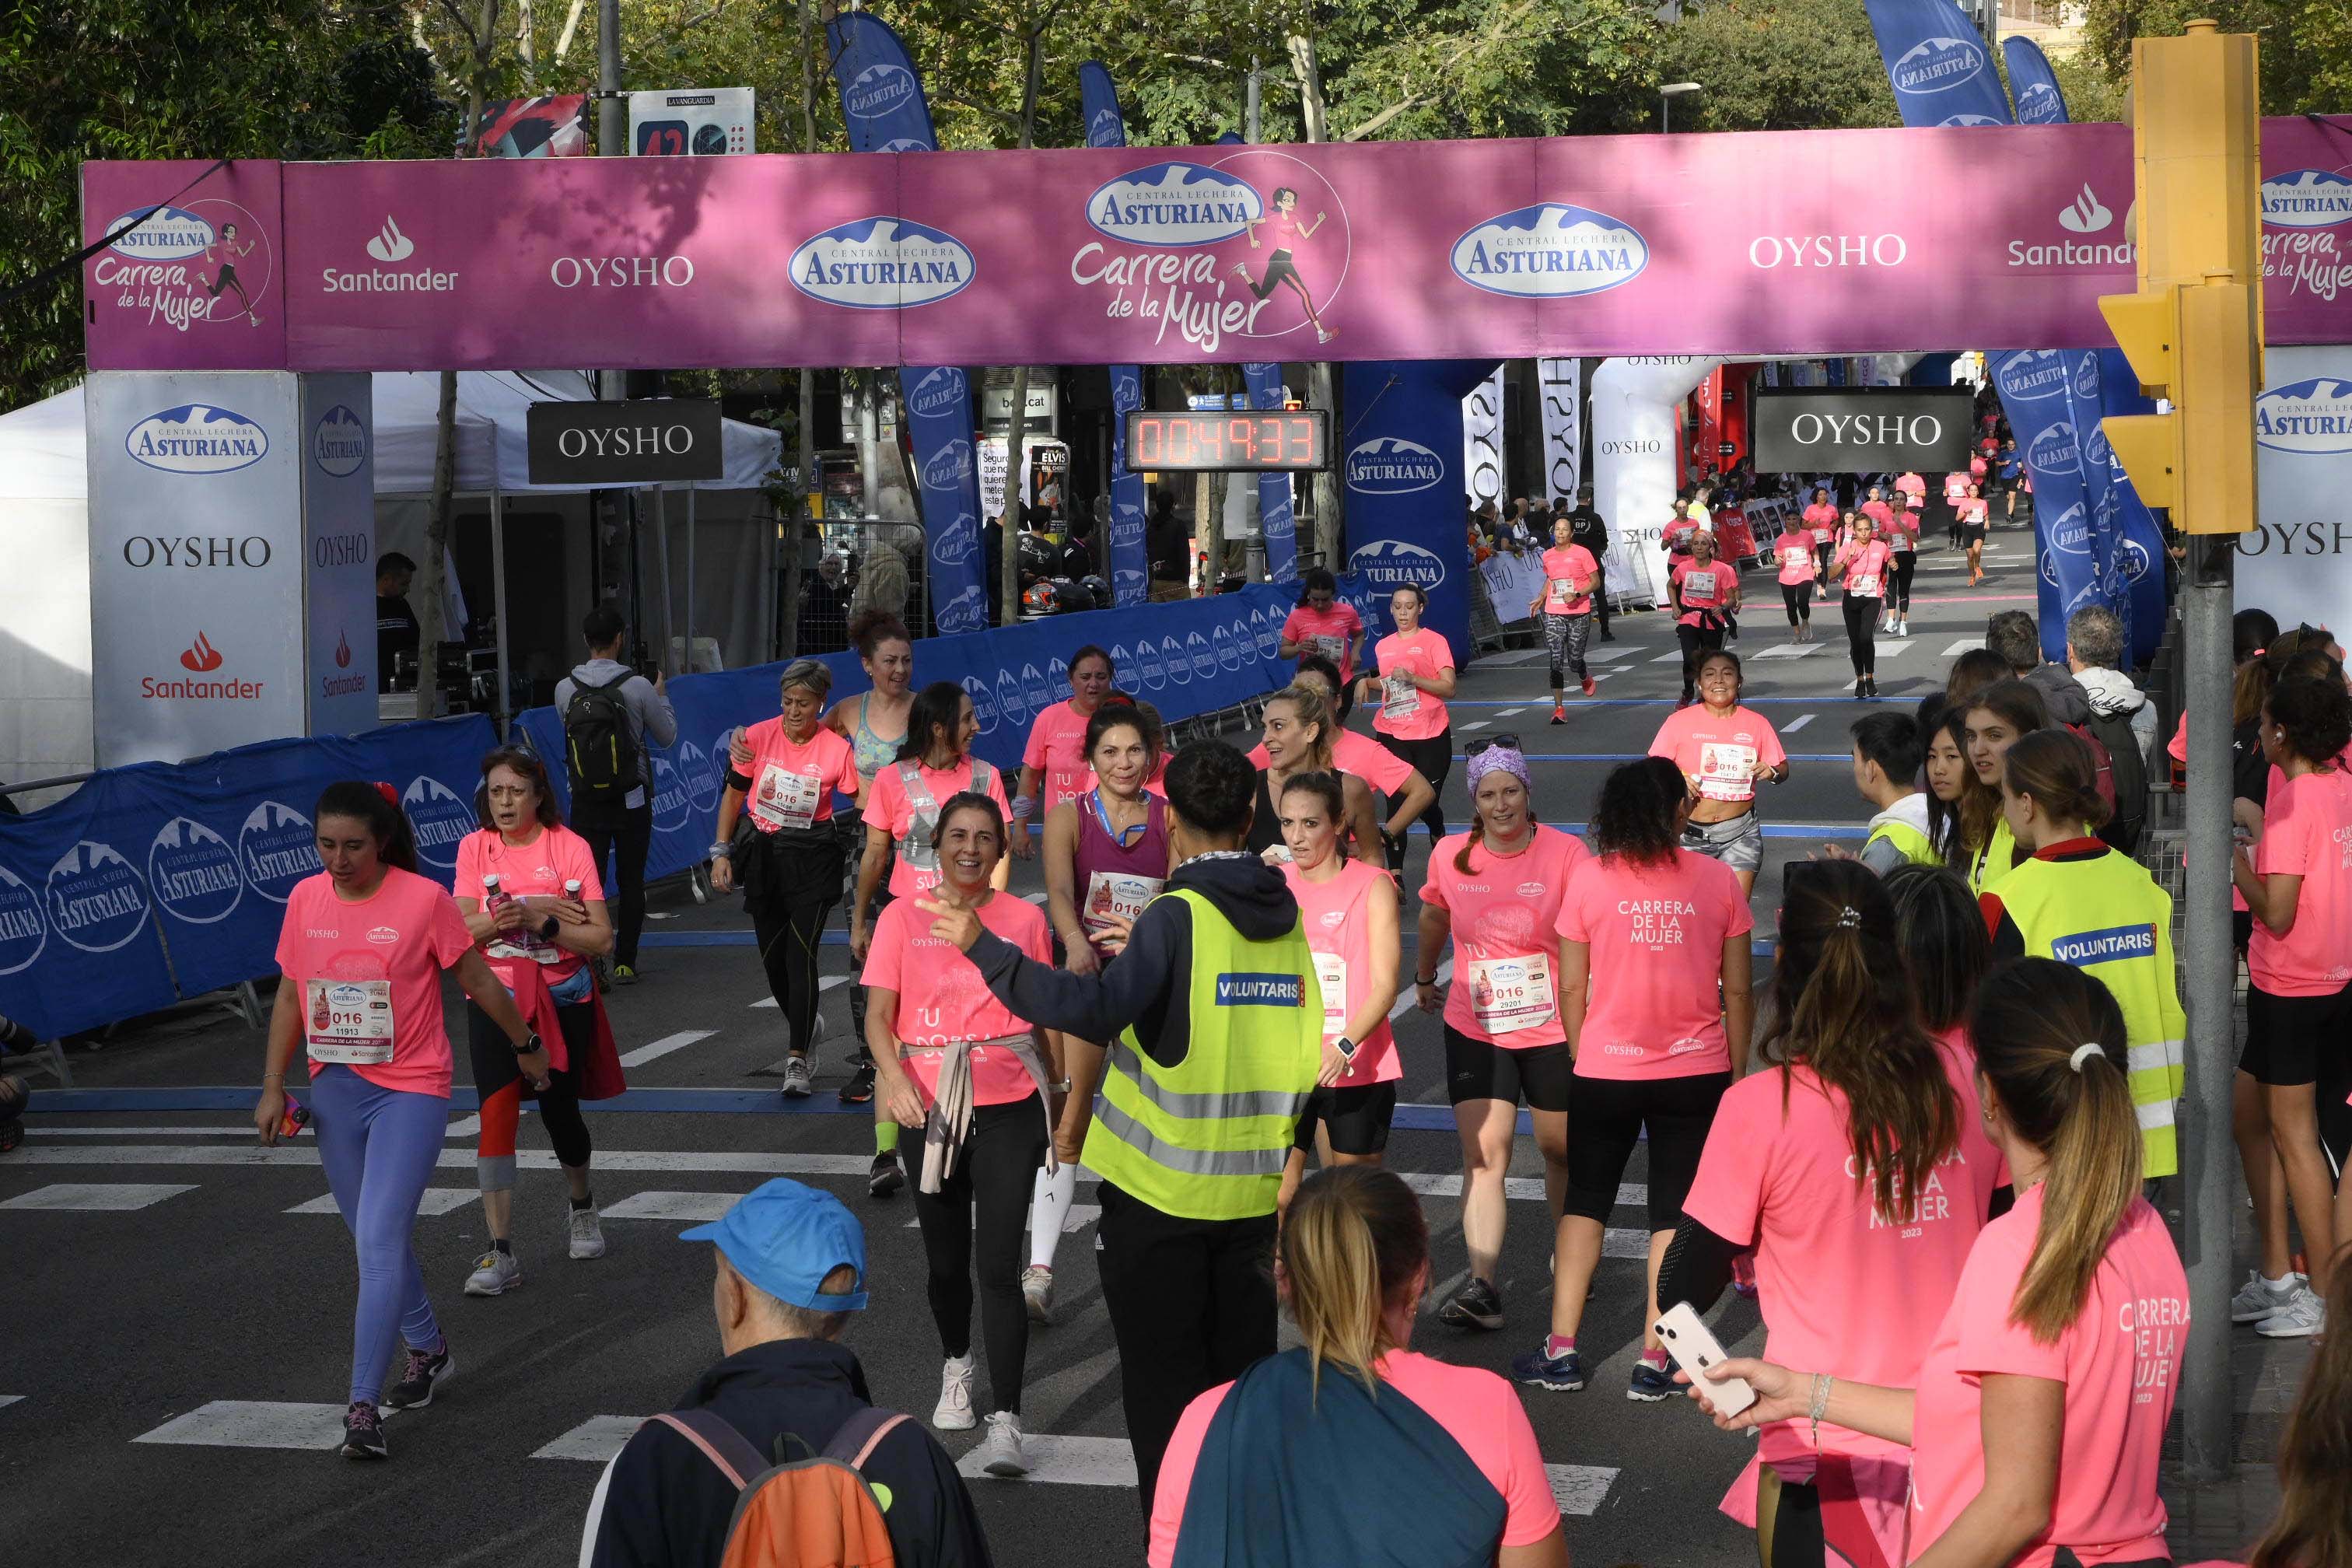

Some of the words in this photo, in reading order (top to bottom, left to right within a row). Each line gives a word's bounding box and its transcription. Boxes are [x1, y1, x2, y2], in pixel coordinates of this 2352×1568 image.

[677, 96, 715, 106] VANGUARDIA
[1126, 191, 1182, 200] CENTRAL
[1188, 190, 1244, 199] LECHERA
[1100, 194, 1248, 225] ASTURIANA
[114, 226, 207, 247] ASTURIANA
[1496, 236, 1556, 247] CENTRAL
[1563, 234, 1626, 245] LECHERA
[2261, 232, 2336, 255] arrera
[831, 249, 890, 258] CENTRAL
[896, 247, 955, 257] LECHERA
[1465, 240, 1633, 275] ASTURIANA
[1748, 234, 1907, 268] OYSHO
[95, 257, 187, 286] Carrera
[551, 256, 694, 287] OYSHO
[803, 251, 961, 285] ASTURIANA
[1071, 242, 1216, 285] Carrera
[2280, 255, 2294, 276] la
[323, 268, 459, 292] Santander
[118, 287, 135, 307] de
[138, 287, 151, 307] la
[149, 284, 221, 331] Mujer
[1107, 287, 1134, 317] de
[1140, 287, 1159, 318] la
[1155, 279, 1272, 353] Mujer
[2277, 404, 2330, 413] CENTRAL
[1791, 413, 1942, 446] OYSHO
[137, 430, 259, 457] ASTURIANA
[317, 433, 363, 460] ASTURIANA
[558, 425, 694, 457] OYSHO
[1139, 419, 1314, 462] 00:49:33
[1601, 439, 1661, 455] OYSHO
[1041, 453, 1066, 463] ELVIS
[1349, 460, 1437, 481] ASTURIANA
[123, 536, 271, 568] OYSHO
[315, 533, 367, 568] OYSHO
[1352, 562, 1438, 583] TURIANA
[142, 677, 263, 699] Santander
[323, 671, 366, 698] Santander
[1720, 763, 1738, 772] 016
[1055, 773, 1071, 786] TU
[777, 792, 797, 804] 016
[408, 813, 473, 848] ASTURIANA
[158, 861, 240, 902] ASTURIANA
[1458, 883, 1490, 893] OYSHO
[1114, 902, 1142, 915] 016
[1618, 901, 1696, 915] CARRERA
[1633, 915, 1654, 929] DE
[1660, 915, 1681, 929] LA
[306, 929, 339, 939] OYSHO
[1630, 929, 1683, 944] MUJER
[1465, 943, 1487, 959] TU
[2056, 933, 2152, 961] VOLUNTARIS
[1219, 982, 1298, 999] VOLUNTARIS
[1496, 986, 1524, 999] 016
[1500, 1000, 1522, 1009] 29201
[332, 1012, 362, 1024] 016
[1605, 1045, 1643, 1056] OYSHO
[1901, 1227, 1923, 1239] 2023
[2156, 1328, 2174, 1356] LA
